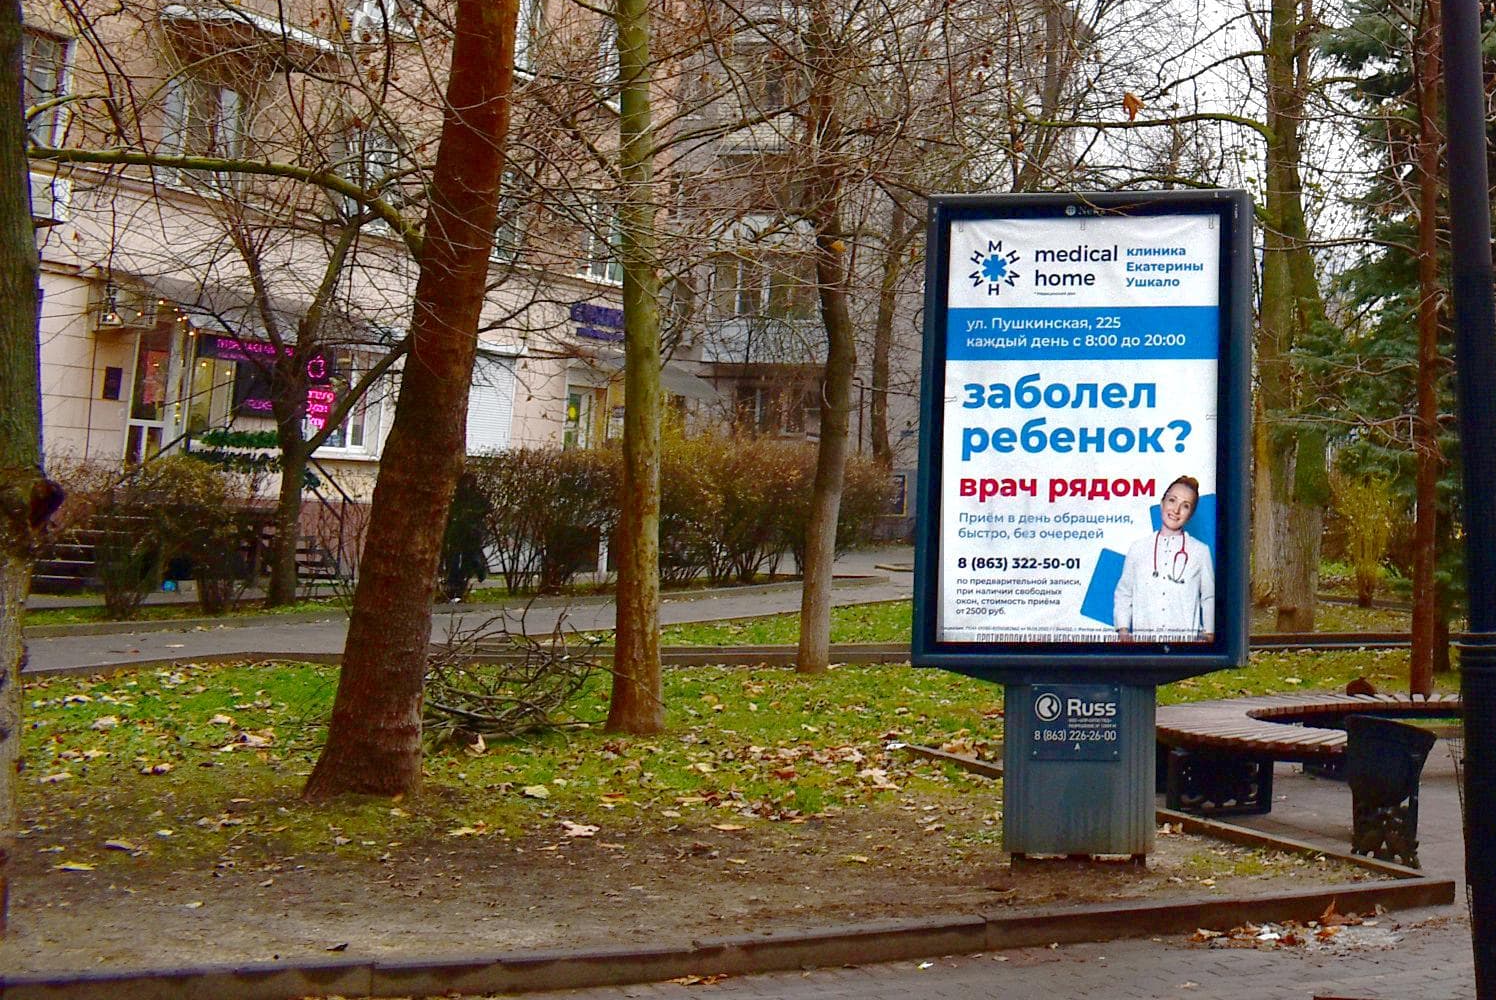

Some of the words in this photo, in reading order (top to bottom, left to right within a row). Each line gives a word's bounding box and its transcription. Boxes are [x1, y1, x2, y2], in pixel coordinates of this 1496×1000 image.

[1035, 245, 1118, 263] medical
[1126, 246, 1186, 256] клиника
[1126, 261, 1203, 273] Екатерины
[1035, 270, 1095, 286] home
[1126, 277, 1180, 288] Ушкало
[966, 319, 987, 331] ул.
[992, 317, 1092, 330] Пушкинская,
[1096, 317, 1121, 329] 225
[966, 335, 1027, 349] каждый
[1031, 337, 1069, 349] день
[1073, 337, 1081, 347] с
[1085, 335, 1117, 347] 8:00
[1120, 337, 1140, 349] до
[1144, 334, 1185, 346] 20:00
[962, 373, 1156, 409] заболел
[961, 417, 1192, 461] ребенок?
[959, 478, 1037, 502] врач
[1049, 478, 1155, 503] рядом
[959, 512, 1004, 524] Приём
[1009, 515, 1015, 524] в
[1018, 515, 1051, 525] день
[1054, 512, 1134, 526] обращения,
[958, 527, 1010, 541] быстро,
[1013, 528, 1036, 539] без
[1040, 528, 1104, 541] очередей
[958, 558, 966, 569] 8
[971, 557, 1008, 571] (863)
[1012, 558, 1081, 569] 322-50-01
[970, 576, 1047, 587] предварительной
[1049, 578, 1081, 587] записи,
[1015, 587, 1062, 596] свободных
[956, 598, 978, 606] окон,
[966, 607, 987, 615] 2500
[988, 606, 1006, 618] руб.
[1067, 699, 1117, 717] Russ
[1034, 730, 1041, 741] 8
[1043, 729, 1067, 742] (863)
[1069, 730, 1116, 741] 226-26-00
